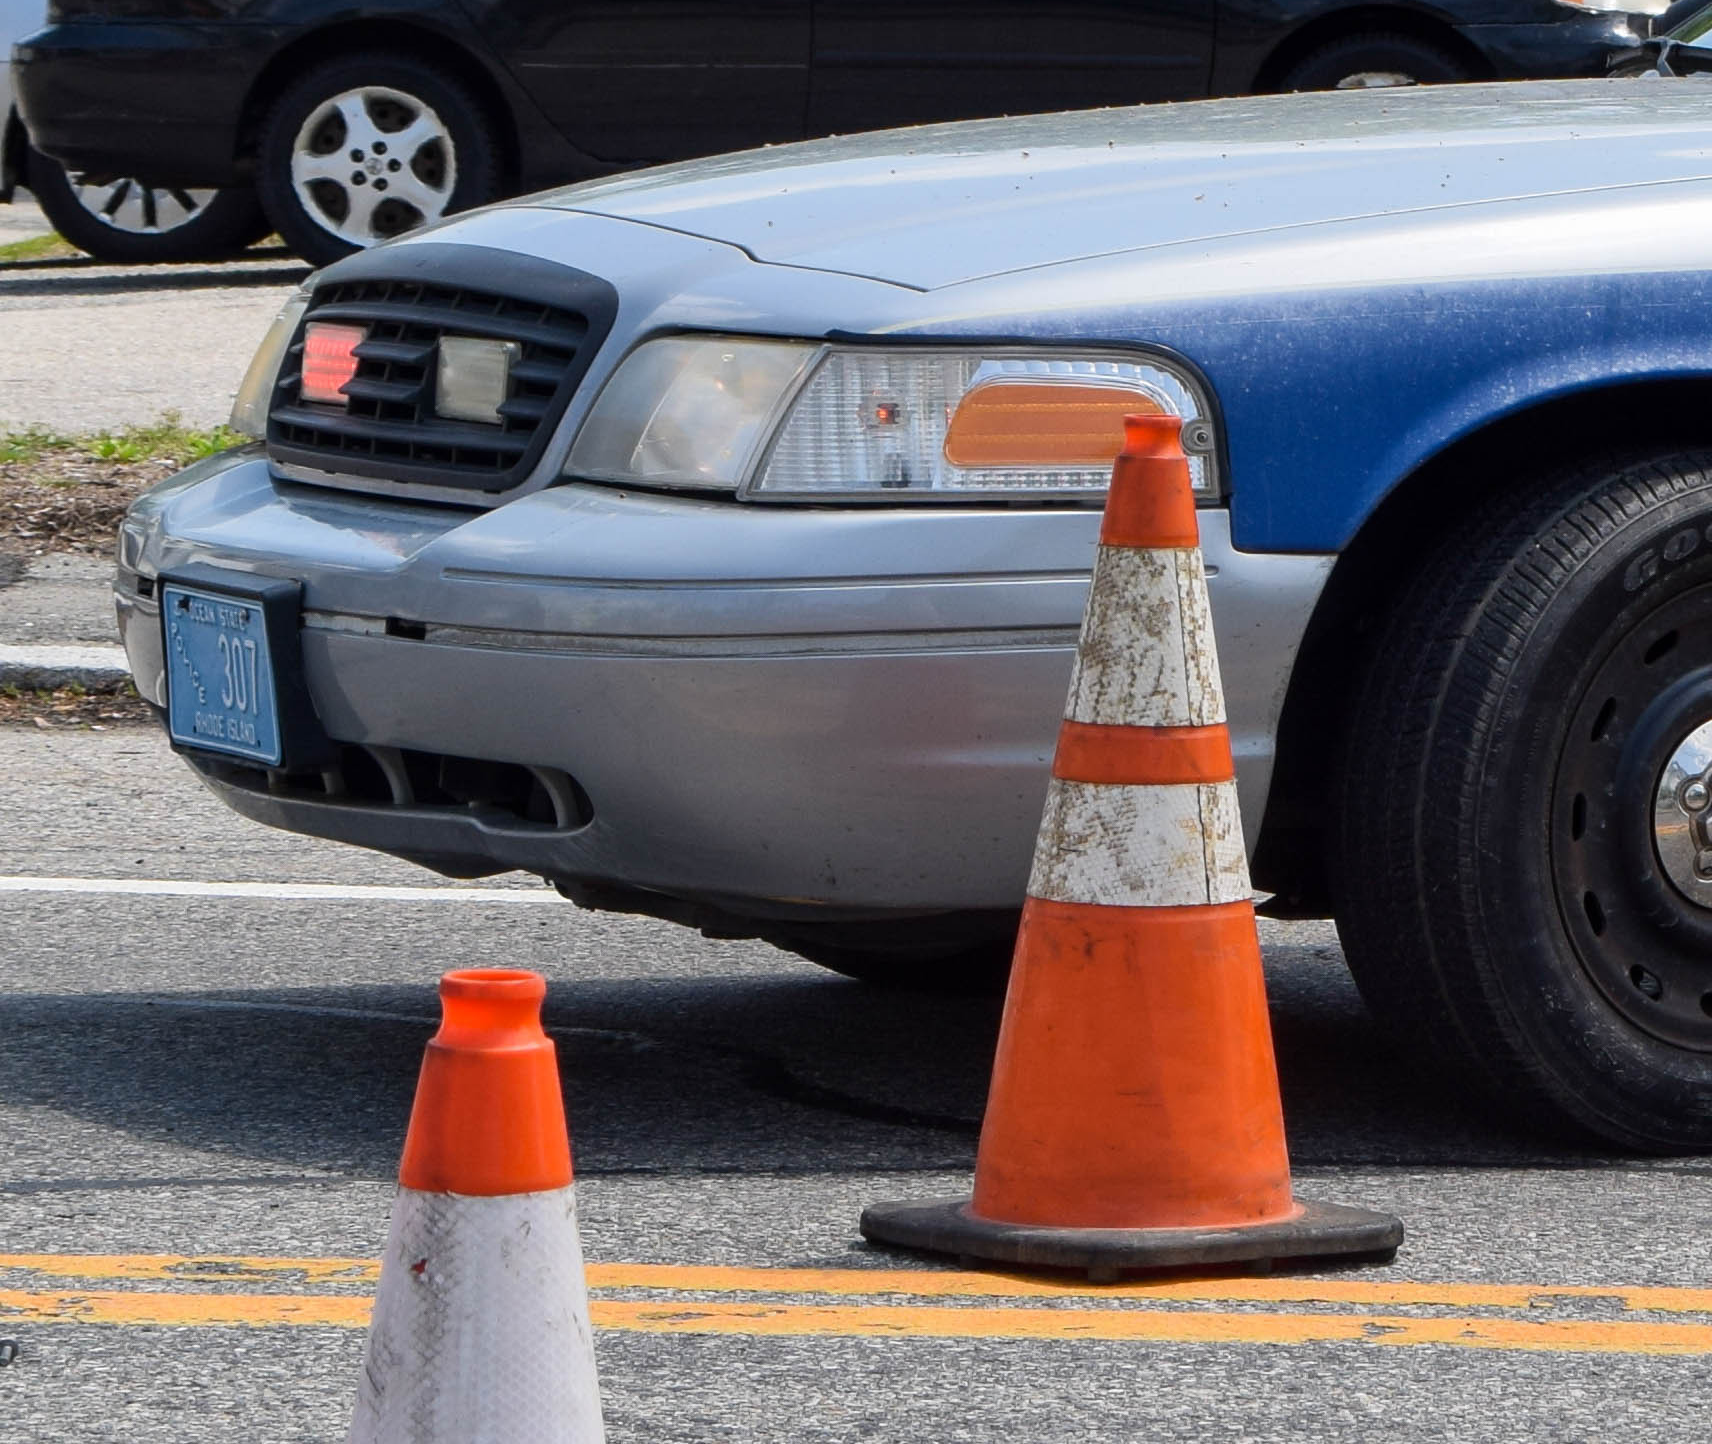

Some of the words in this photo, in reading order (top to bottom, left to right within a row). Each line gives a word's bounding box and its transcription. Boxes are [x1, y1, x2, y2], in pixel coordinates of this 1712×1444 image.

[171, 622, 206, 704] POLICE
[218, 634, 258, 715] 307
[195, 711, 225, 738] RHODE
[227, 718, 257, 745] ISLAND
